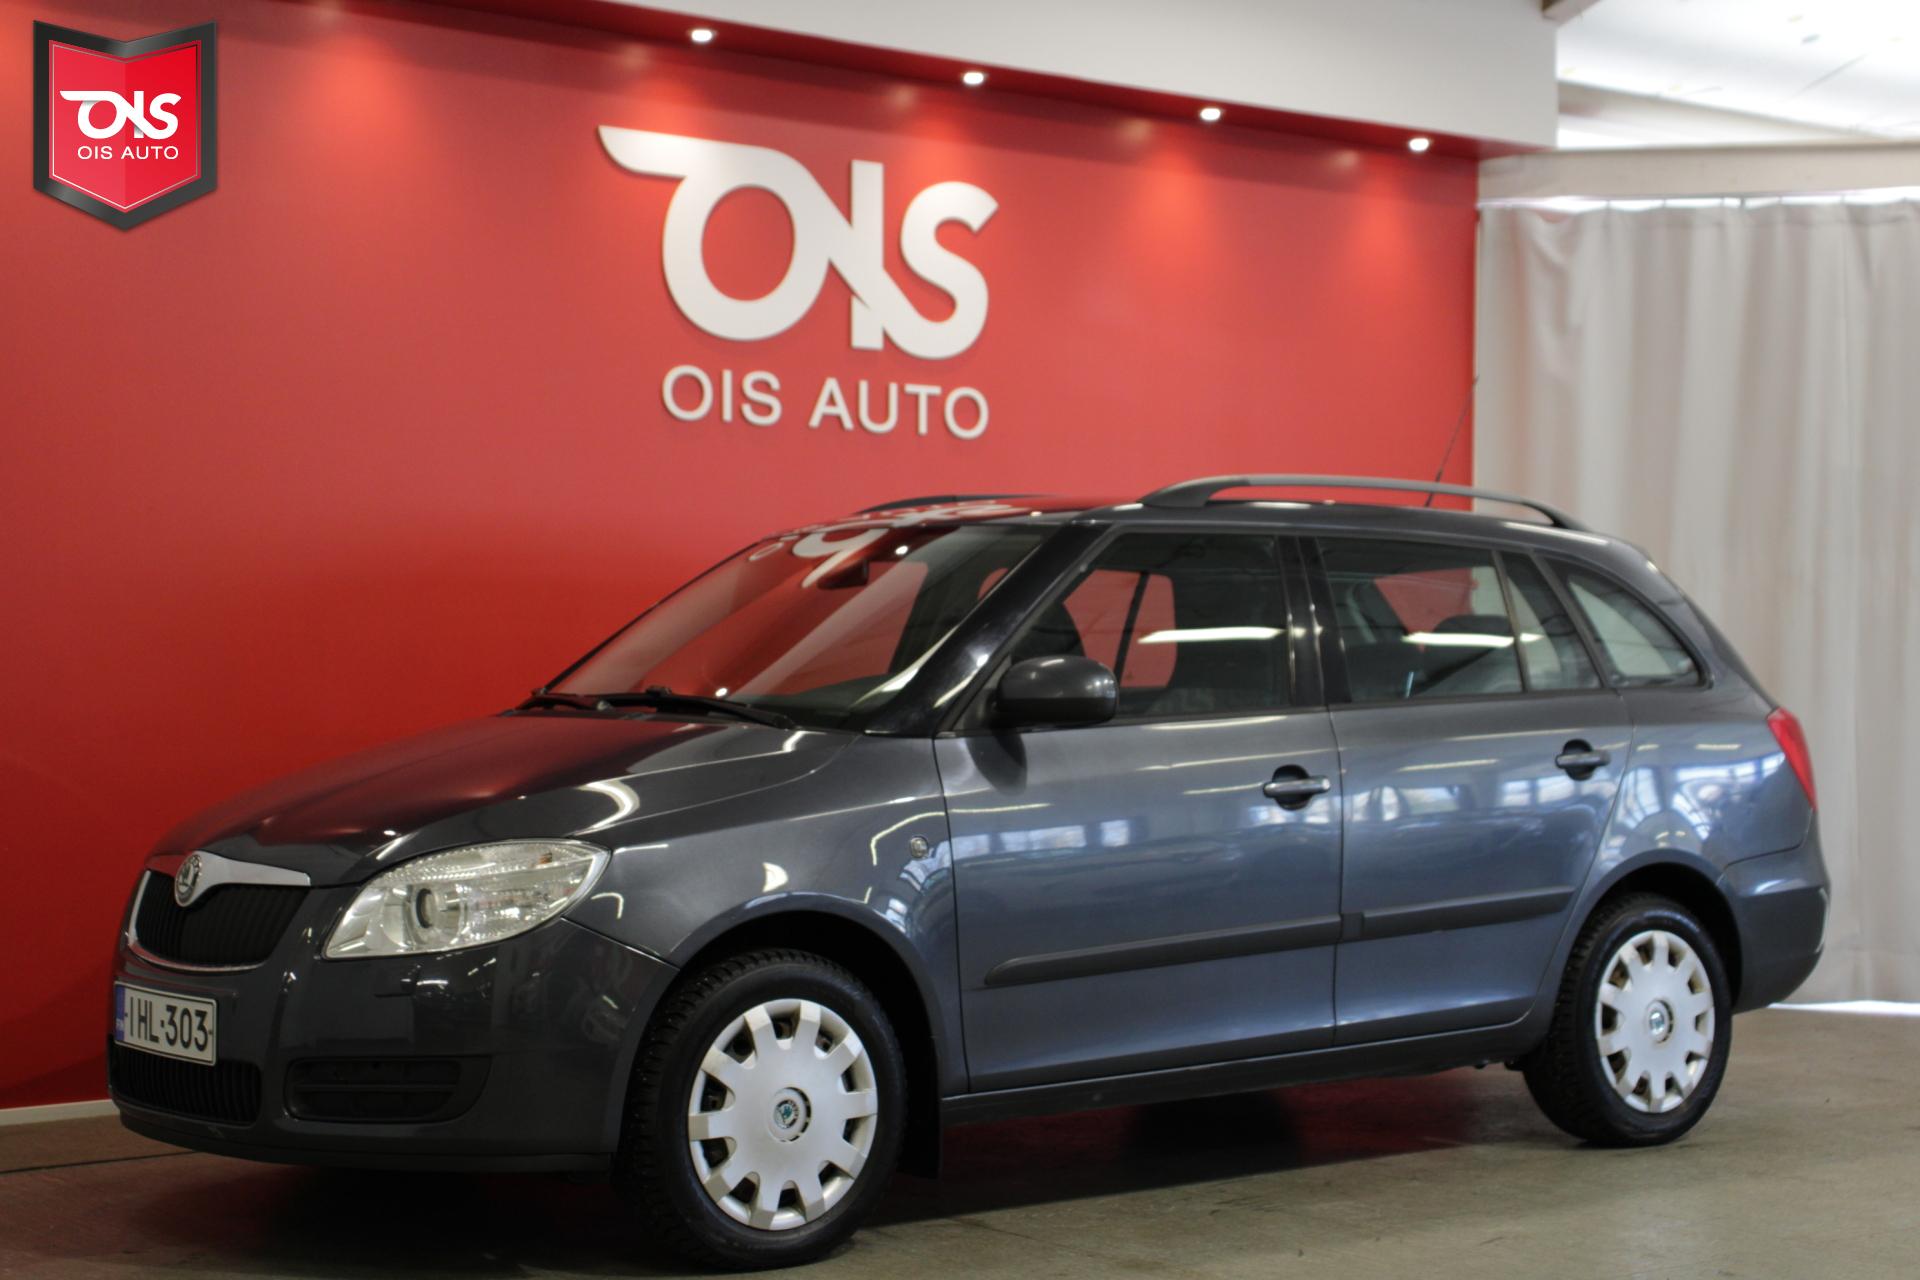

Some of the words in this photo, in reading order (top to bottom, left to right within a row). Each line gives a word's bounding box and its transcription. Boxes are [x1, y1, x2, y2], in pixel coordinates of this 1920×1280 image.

[597, 124, 999, 361] OIS
[661, 364, 783, 427] OIS
[807, 376, 990, 440] AUTO
[129, 996, 209, 1052] IHL-303
